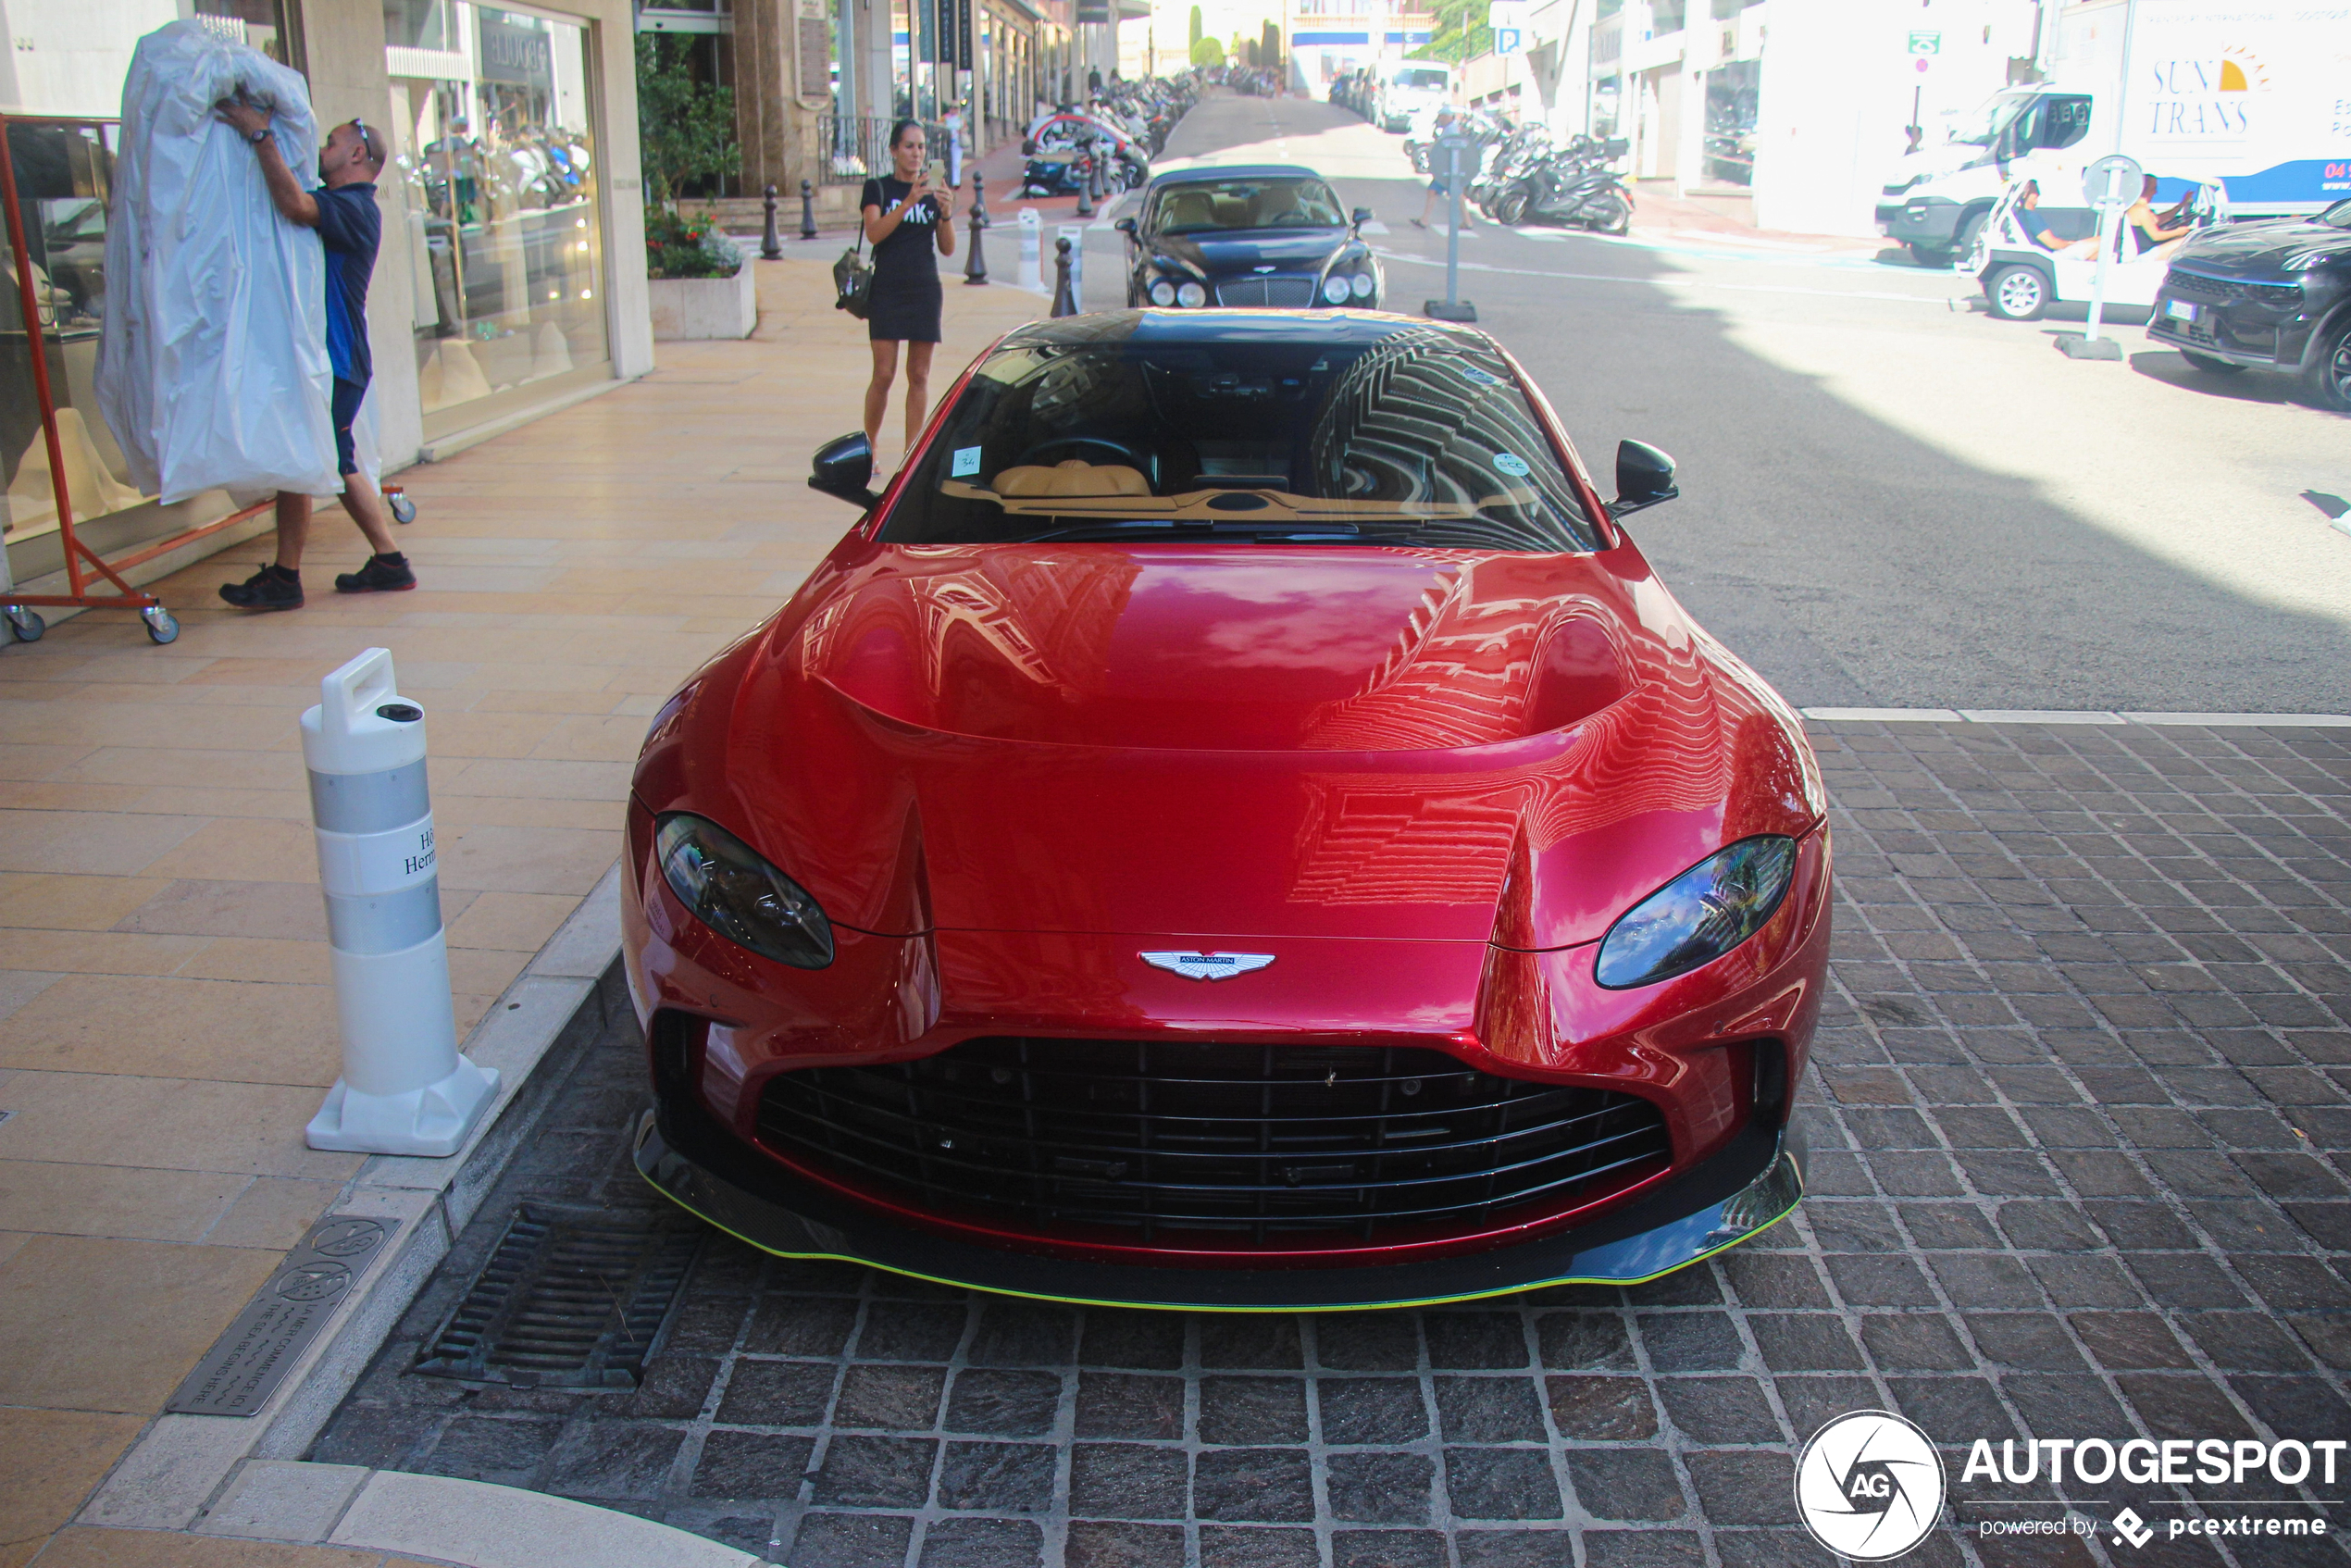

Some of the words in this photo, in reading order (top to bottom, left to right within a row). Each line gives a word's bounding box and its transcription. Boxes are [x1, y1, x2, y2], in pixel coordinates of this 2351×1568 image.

[1502, 31, 1516, 51] P
[2152, 59, 2213, 94] SUN
[2148, 101, 2249, 134] TRANS
[2325, 163, 2345, 179] 04
[260, 1303, 282, 1320] THE
[302, 1304, 318, 1314] LA
[244, 1322, 267, 1339] SEA
[285, 1317, 308, 1337] MER
[216, 1341, 251, 1376] BEGINS
[242, 1338, 292, 1393] COMMENCE
[189, 1377, 221, 1406] HERE
